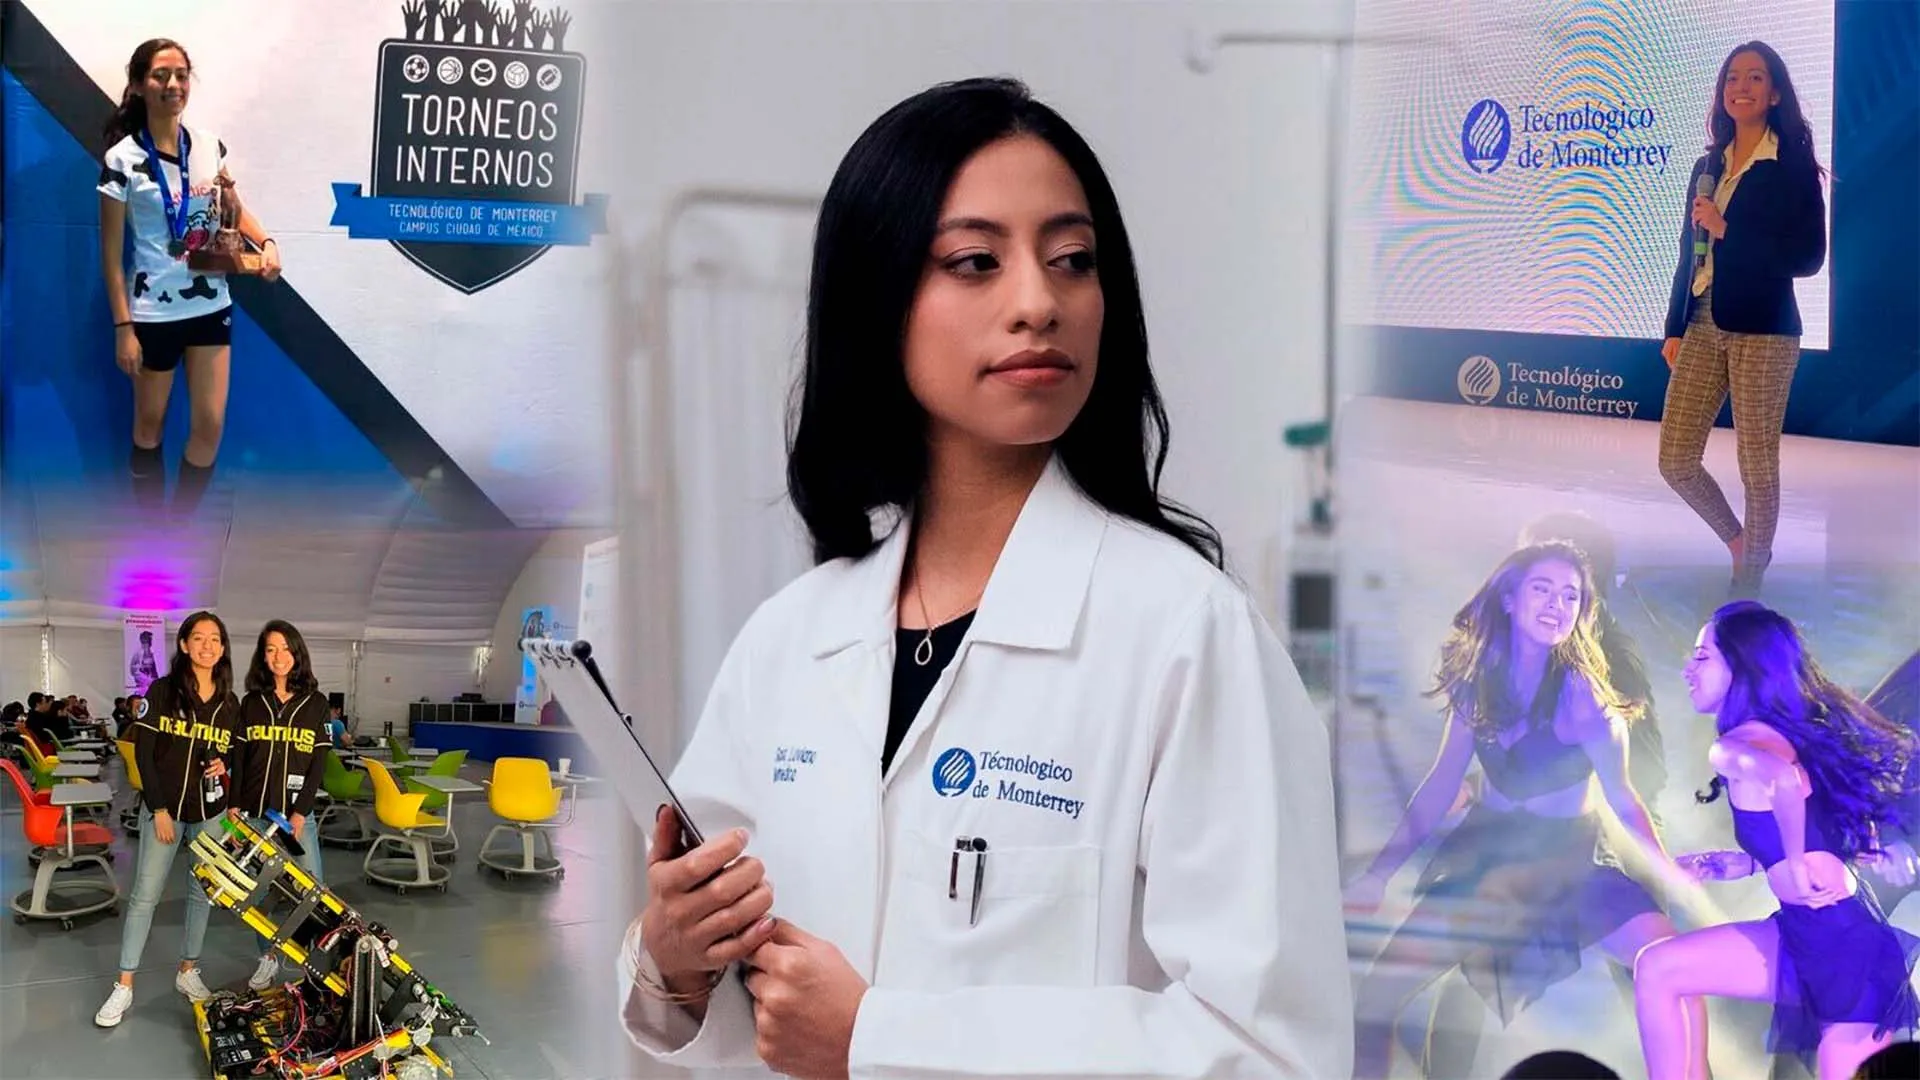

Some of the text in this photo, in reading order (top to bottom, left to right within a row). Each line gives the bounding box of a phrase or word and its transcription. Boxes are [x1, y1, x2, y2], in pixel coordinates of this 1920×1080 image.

[402, 93, 558, 142] TORNEOS
[1519, 100, 1654, 140] Tecnológico
[396, 144, 554, 188] INTERNOS
[1518, 139, 1672, 175] de Monterrey
[389, 202, 558, 223] TECNOLÓGICO DE MONTERREY
[400, 222, 439, 234] CAMPUS
[446, 223, 481, 236] CIUDAD
[488, 224, 500, 236] DE
[1507, 362, 1624, 393] Tecnológico
[1506, 386, 1640, 419] de Monterrey
[979, 751, 1073, 782] Técnologico
[972, 780, 1085, 819] de Monterrey
